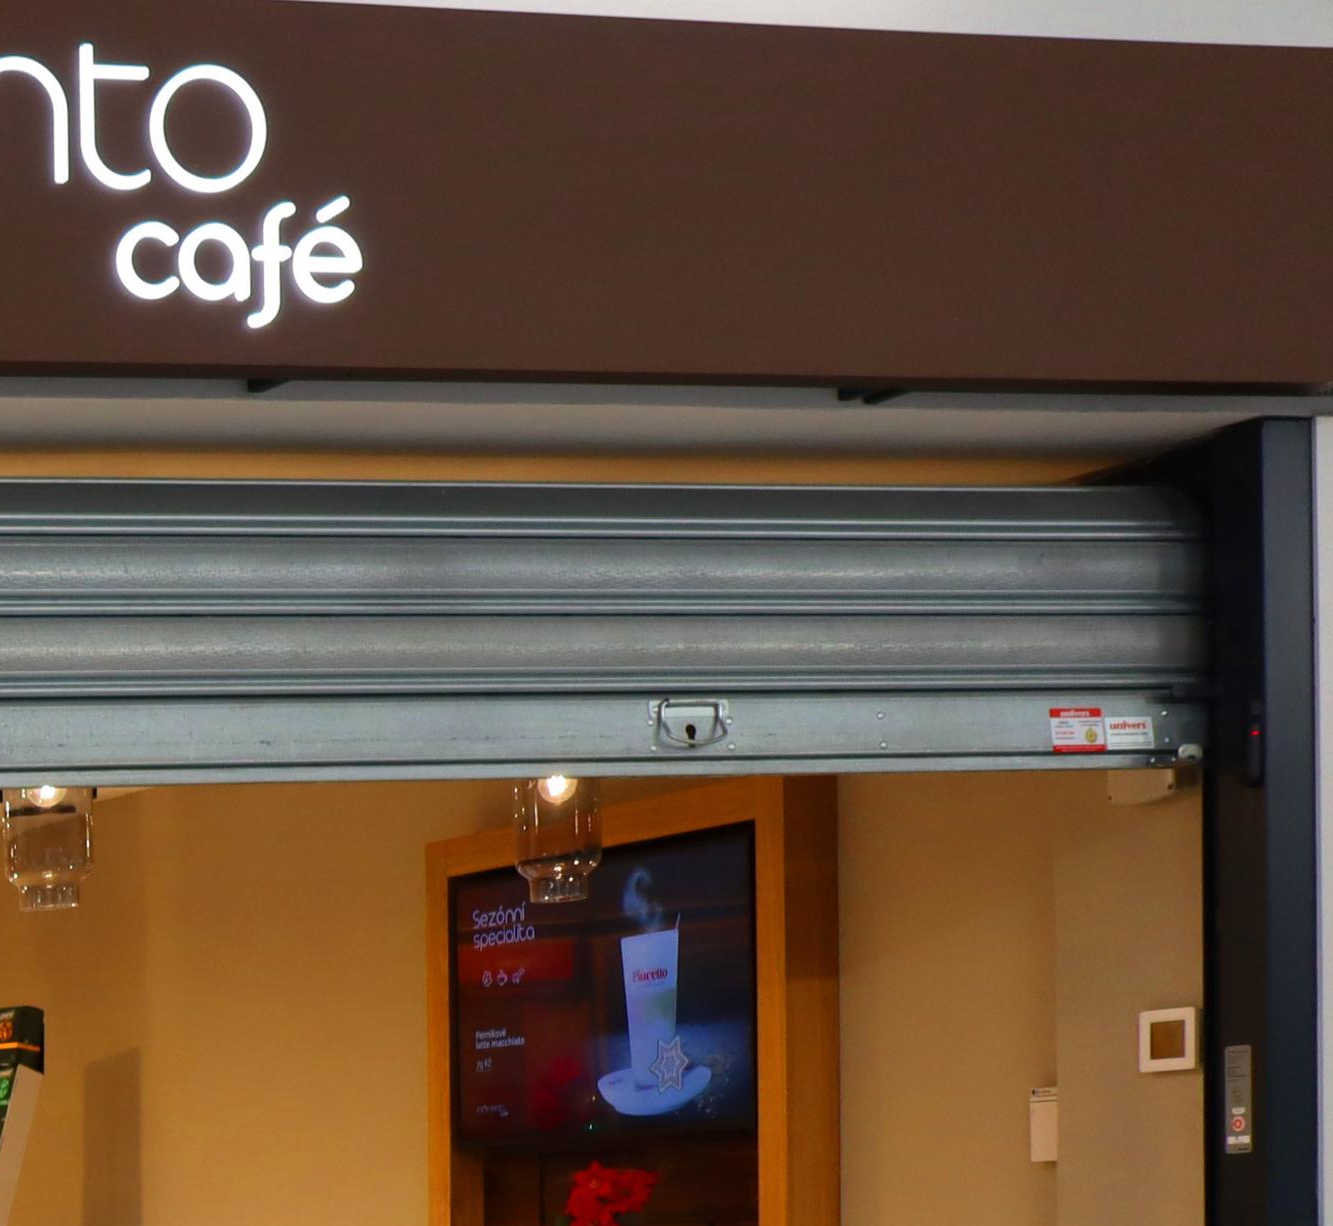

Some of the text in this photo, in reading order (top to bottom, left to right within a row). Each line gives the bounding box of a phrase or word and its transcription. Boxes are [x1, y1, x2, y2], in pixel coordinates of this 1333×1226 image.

[114, 194, 365, 330] café
[472, 900, 526, 929] Sezónní
[473, 922, 536, 953] specialita
